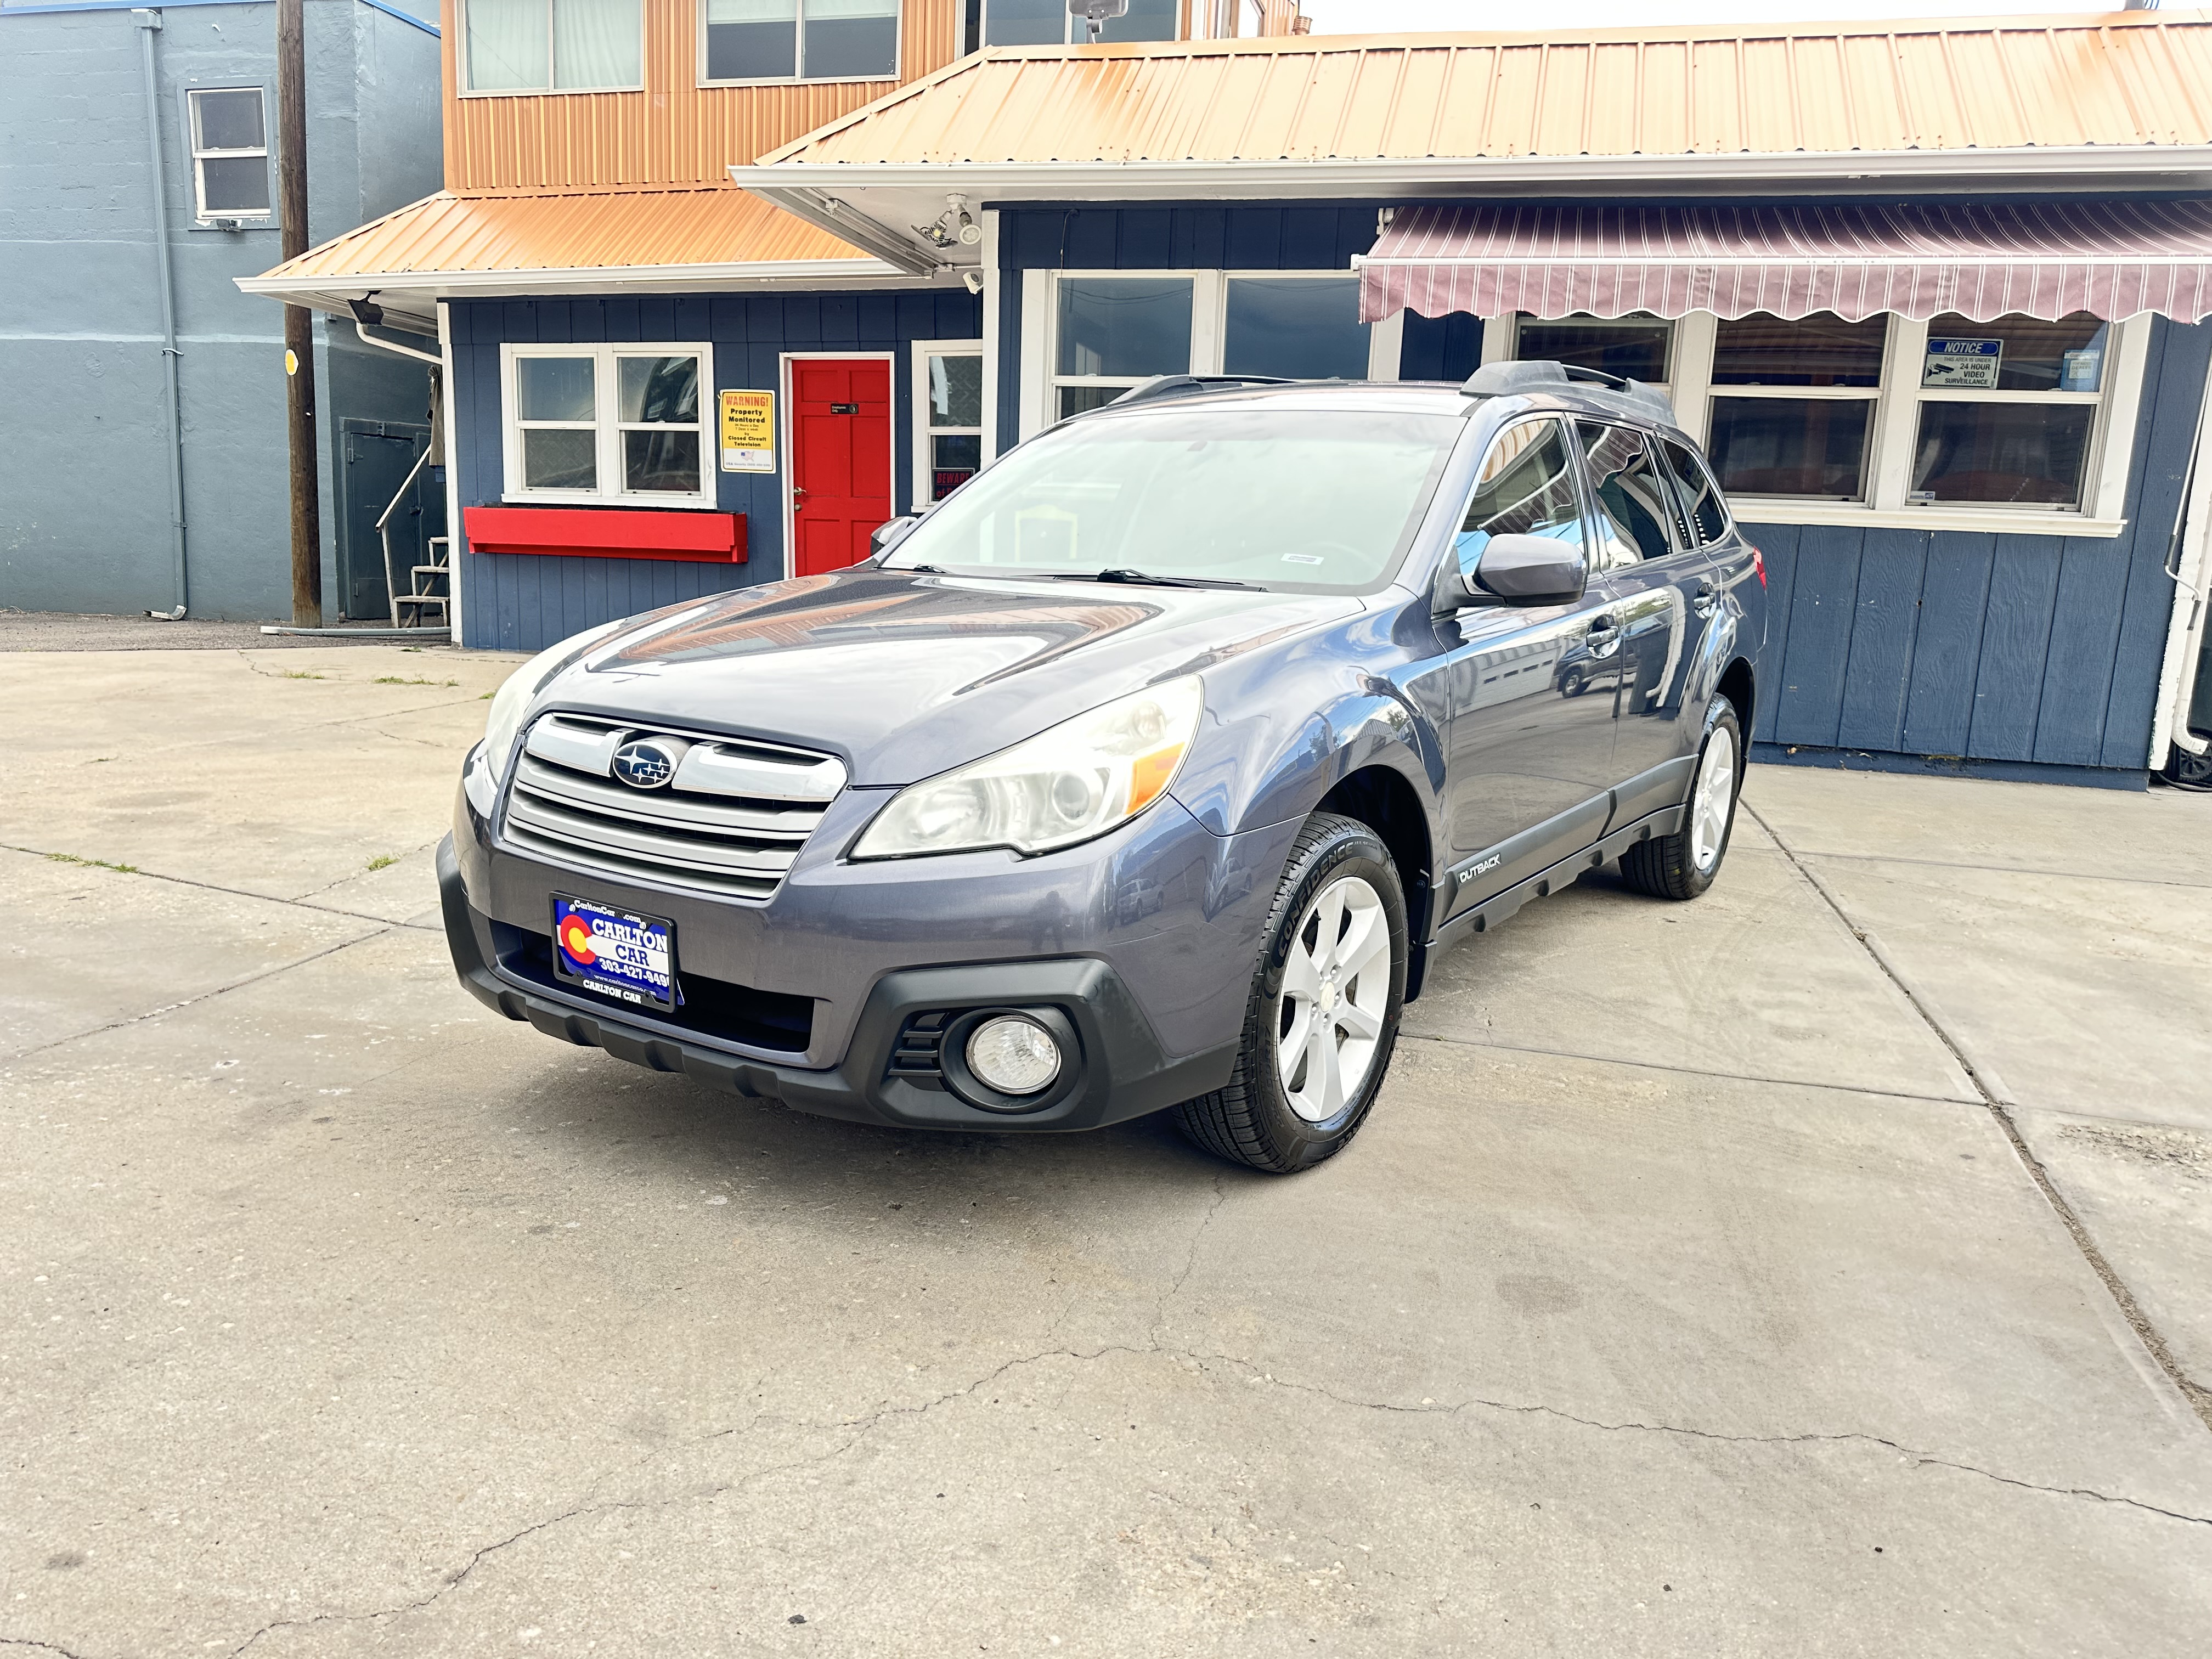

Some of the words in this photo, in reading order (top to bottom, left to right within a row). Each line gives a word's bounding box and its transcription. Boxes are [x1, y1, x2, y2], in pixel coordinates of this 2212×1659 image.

[1944, 342, 1983, 353] NOTICE
[726, 396, 769, 407] WARNING!
[1459, 854, 1500, 883] OUTBACK
[1278, 842, 1353, 957] CONFIDENCE
[592, 918, 668, 952] CARLTON
[616, 944, 650, 967] CAR
[583, 979, 622, 998] CARLTON
[623, 991, 641, 1004] CAR
